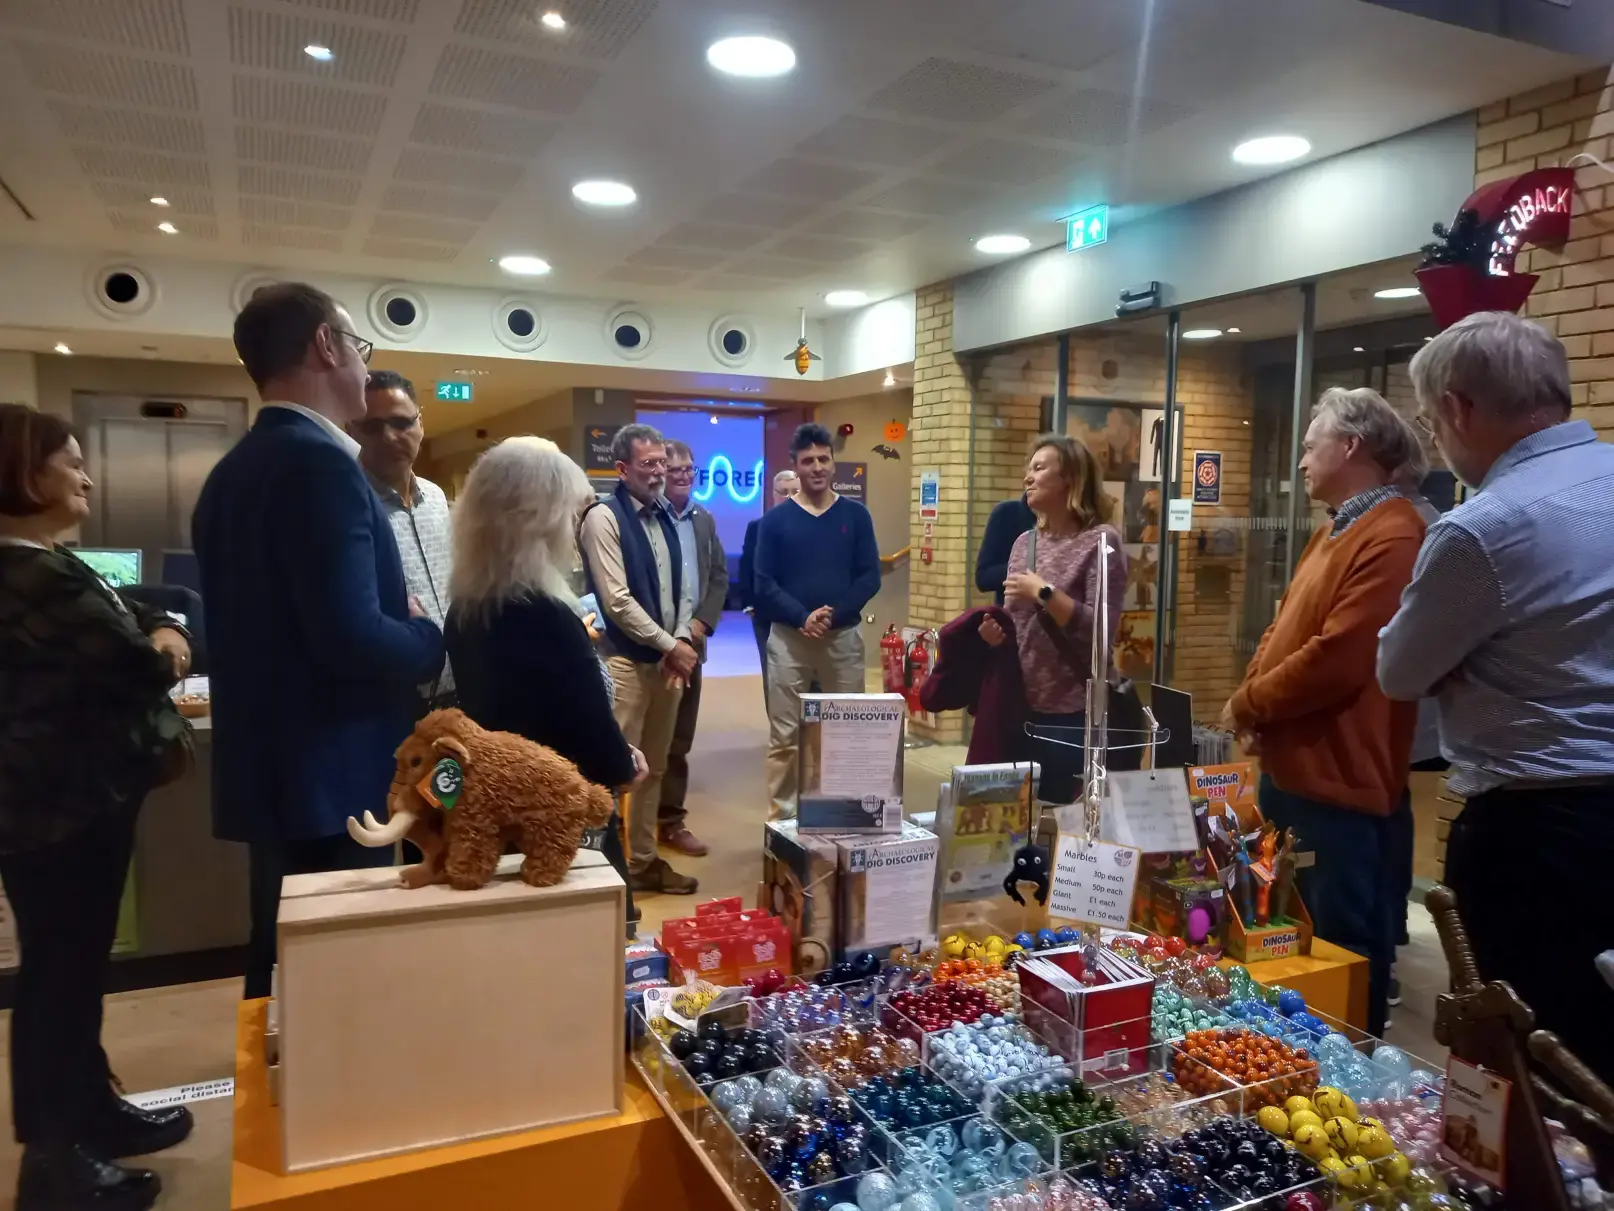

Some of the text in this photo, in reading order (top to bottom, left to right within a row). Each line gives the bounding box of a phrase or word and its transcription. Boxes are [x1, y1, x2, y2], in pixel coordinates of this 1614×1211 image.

[832, 482, 862, 490] Galleries
[843, 712, 899, 720] DISCOVERY
[1196, 772, 1239, 788] DINOSAUR
[1207, 785, 1226, 798] PEN
[867, 852, 935, 868] DIG DISCOVERY
[1064, 849, 1098, 863] Marbles
[1057, 863, 1124, 883] Small 30p each
[1054, 876, 1123, 896] Medium 50p each
[1053, 889, 1116, 908] Giant £1 each
[1050, 902, 1125, 922] Massive £1.50 each
[1263, 932, 1301, 948] DINOSAUR
[1271, 945, 1289, 956] PEN
[181, 1081, 231, 1094] Please
[140, 1094, 186, 1107] social
